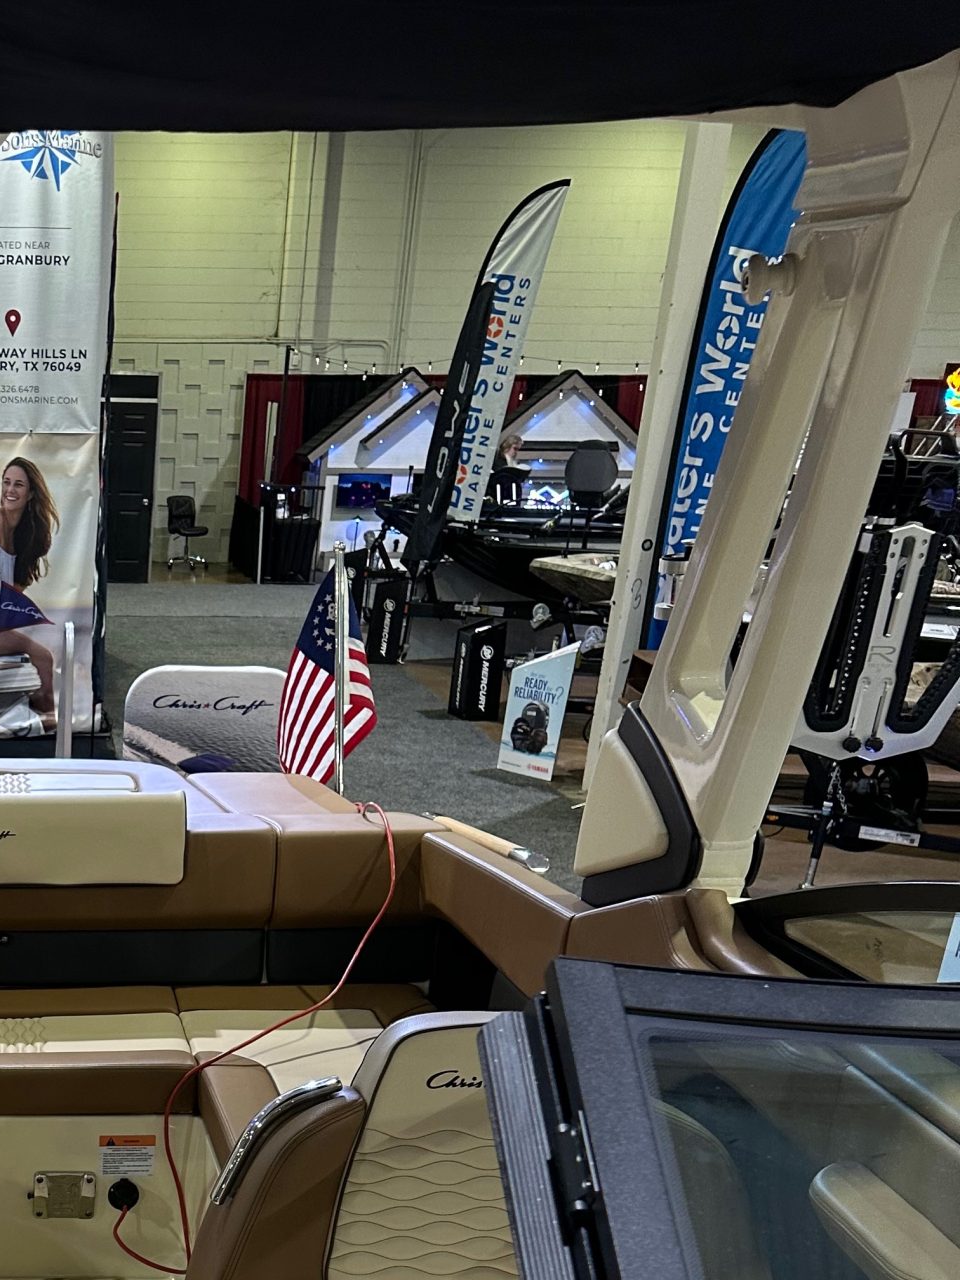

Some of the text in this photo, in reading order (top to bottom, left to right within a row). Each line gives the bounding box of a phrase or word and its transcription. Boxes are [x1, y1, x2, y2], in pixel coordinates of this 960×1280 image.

[24, 241, 50, 250] NEAR
[31, 348, 67, 359] HILLS
[71, 349, 87, 359] LN
[23, 361, 39, 372] TX
[42, 361, 82, 372] 76049
[462, 277, 531, 512] MARINE CENTERS
[379, 611, 392, 658] MERCURY
[477, 660, 490, 713] MERCURY
[524, 676, 549, 691] READY
[152, 694, 274, 716] Chris Craft
[426, 1070, 483, 1089] Chris
